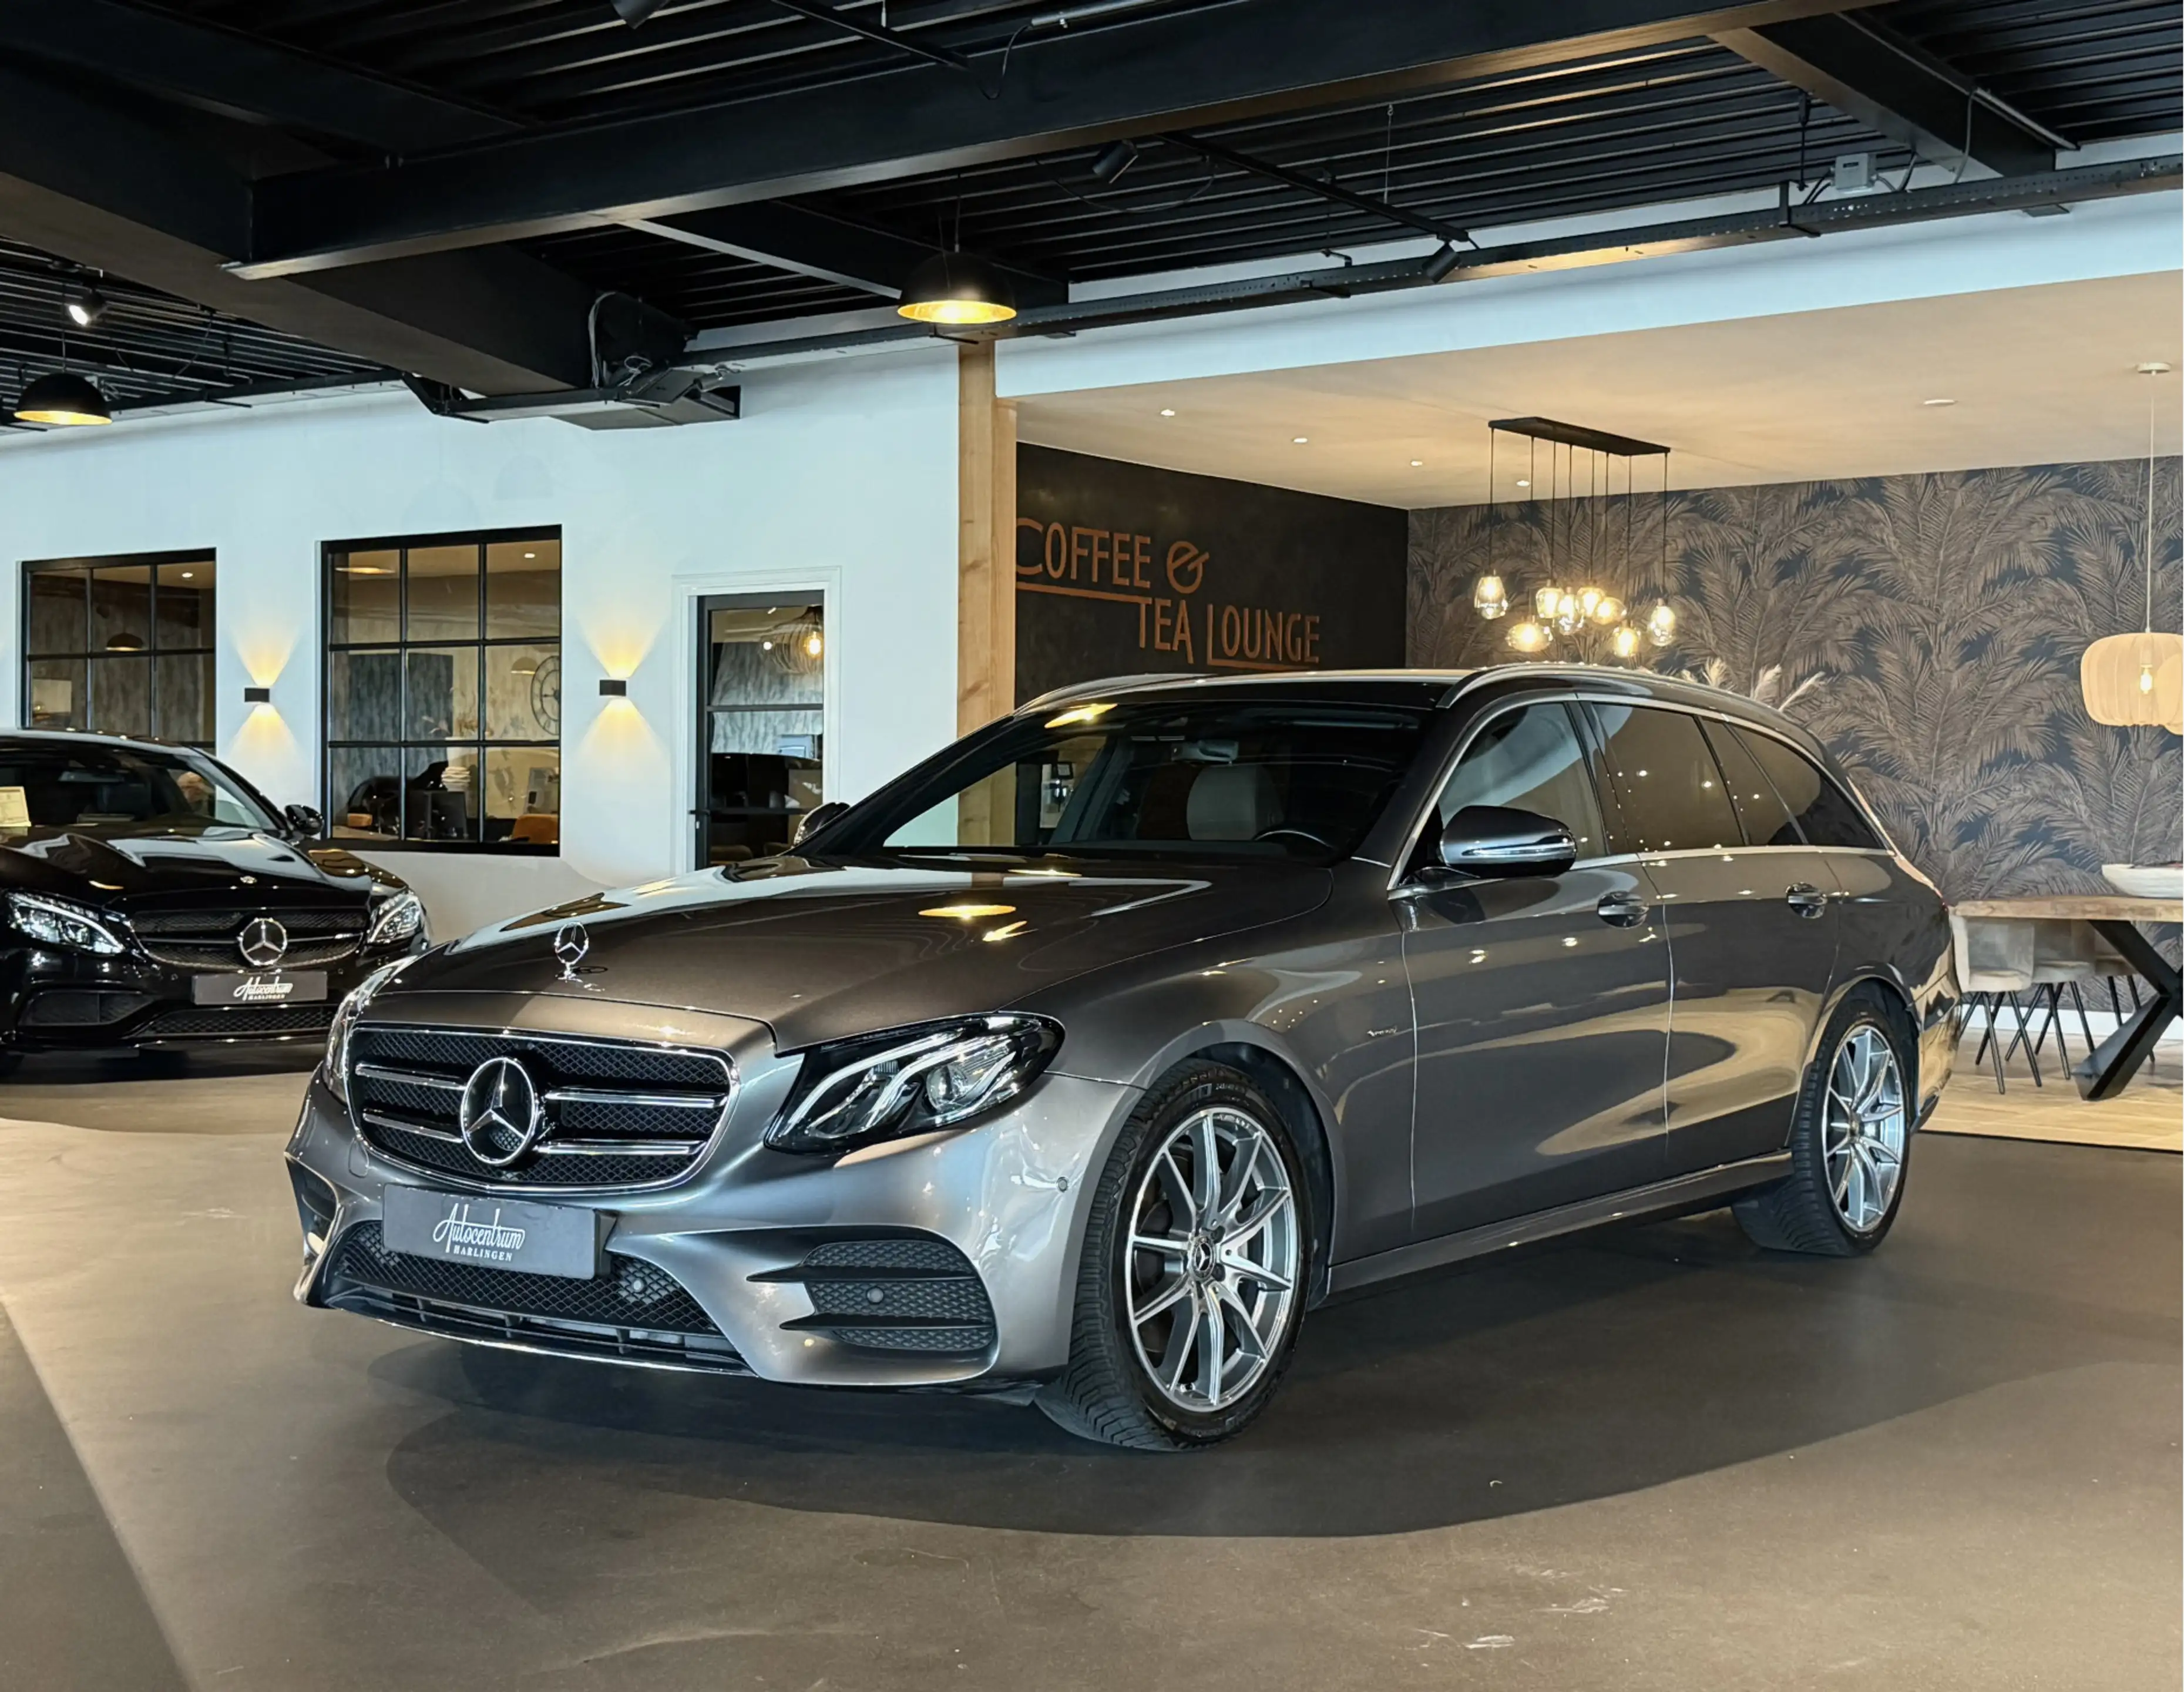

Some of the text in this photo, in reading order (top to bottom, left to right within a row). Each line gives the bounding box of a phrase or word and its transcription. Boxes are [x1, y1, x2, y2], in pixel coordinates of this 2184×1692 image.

[1017, 518, 1151, 588] COFFEE
[1136, 596, 1320, 669] TEA LOUNGE
[432, 1203, 526, 1253] Autocentrum
[453, 1244, 513, 1262] HARLINGEN
